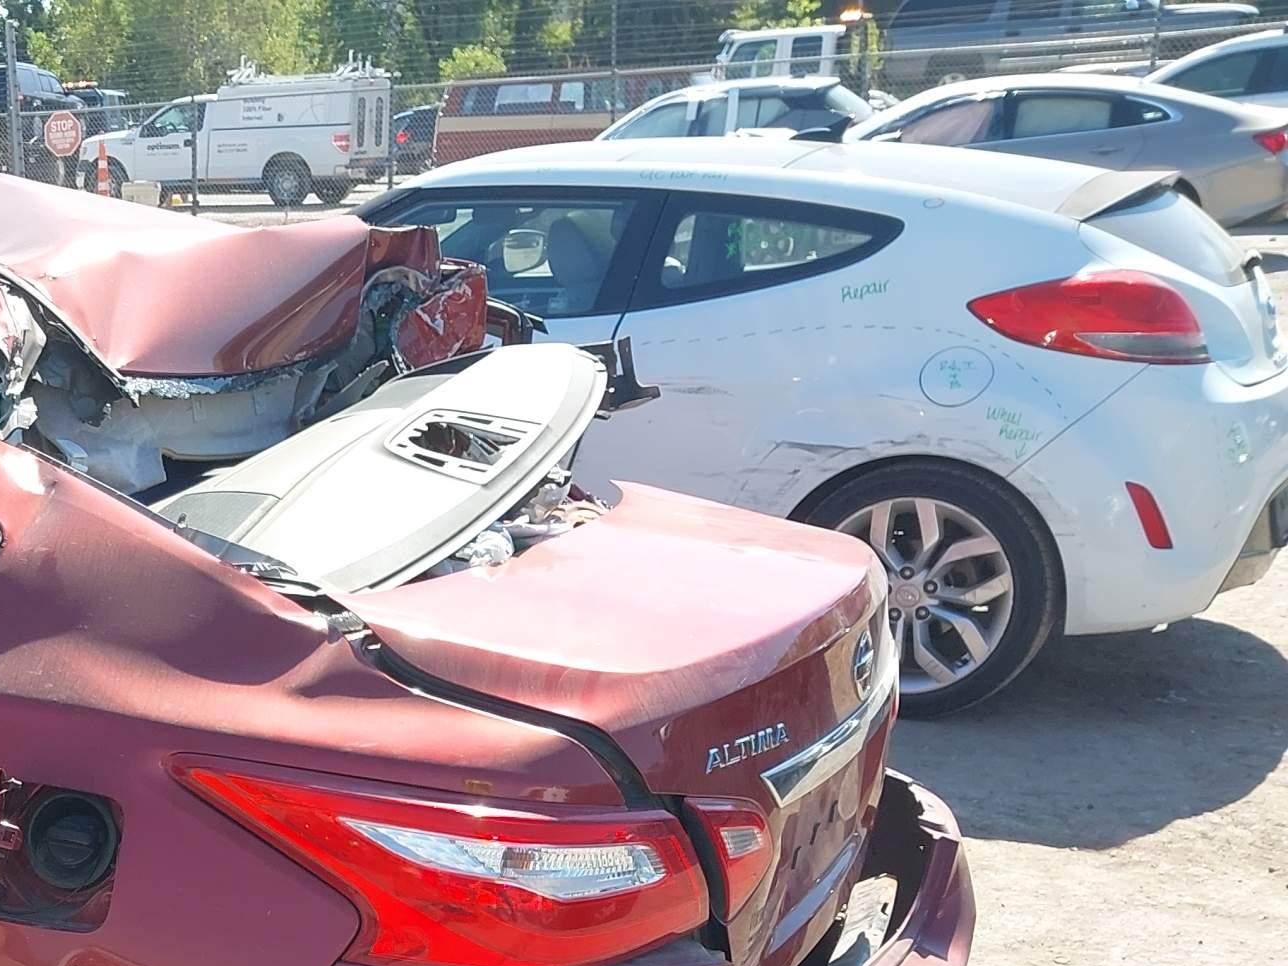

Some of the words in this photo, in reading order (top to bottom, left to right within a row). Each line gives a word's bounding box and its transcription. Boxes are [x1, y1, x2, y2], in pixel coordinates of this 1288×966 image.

[50, 119, 74, 132] STOP
[840, 279, 890, 304] Repair
[705, 722, 790, 774] ALTIMA
